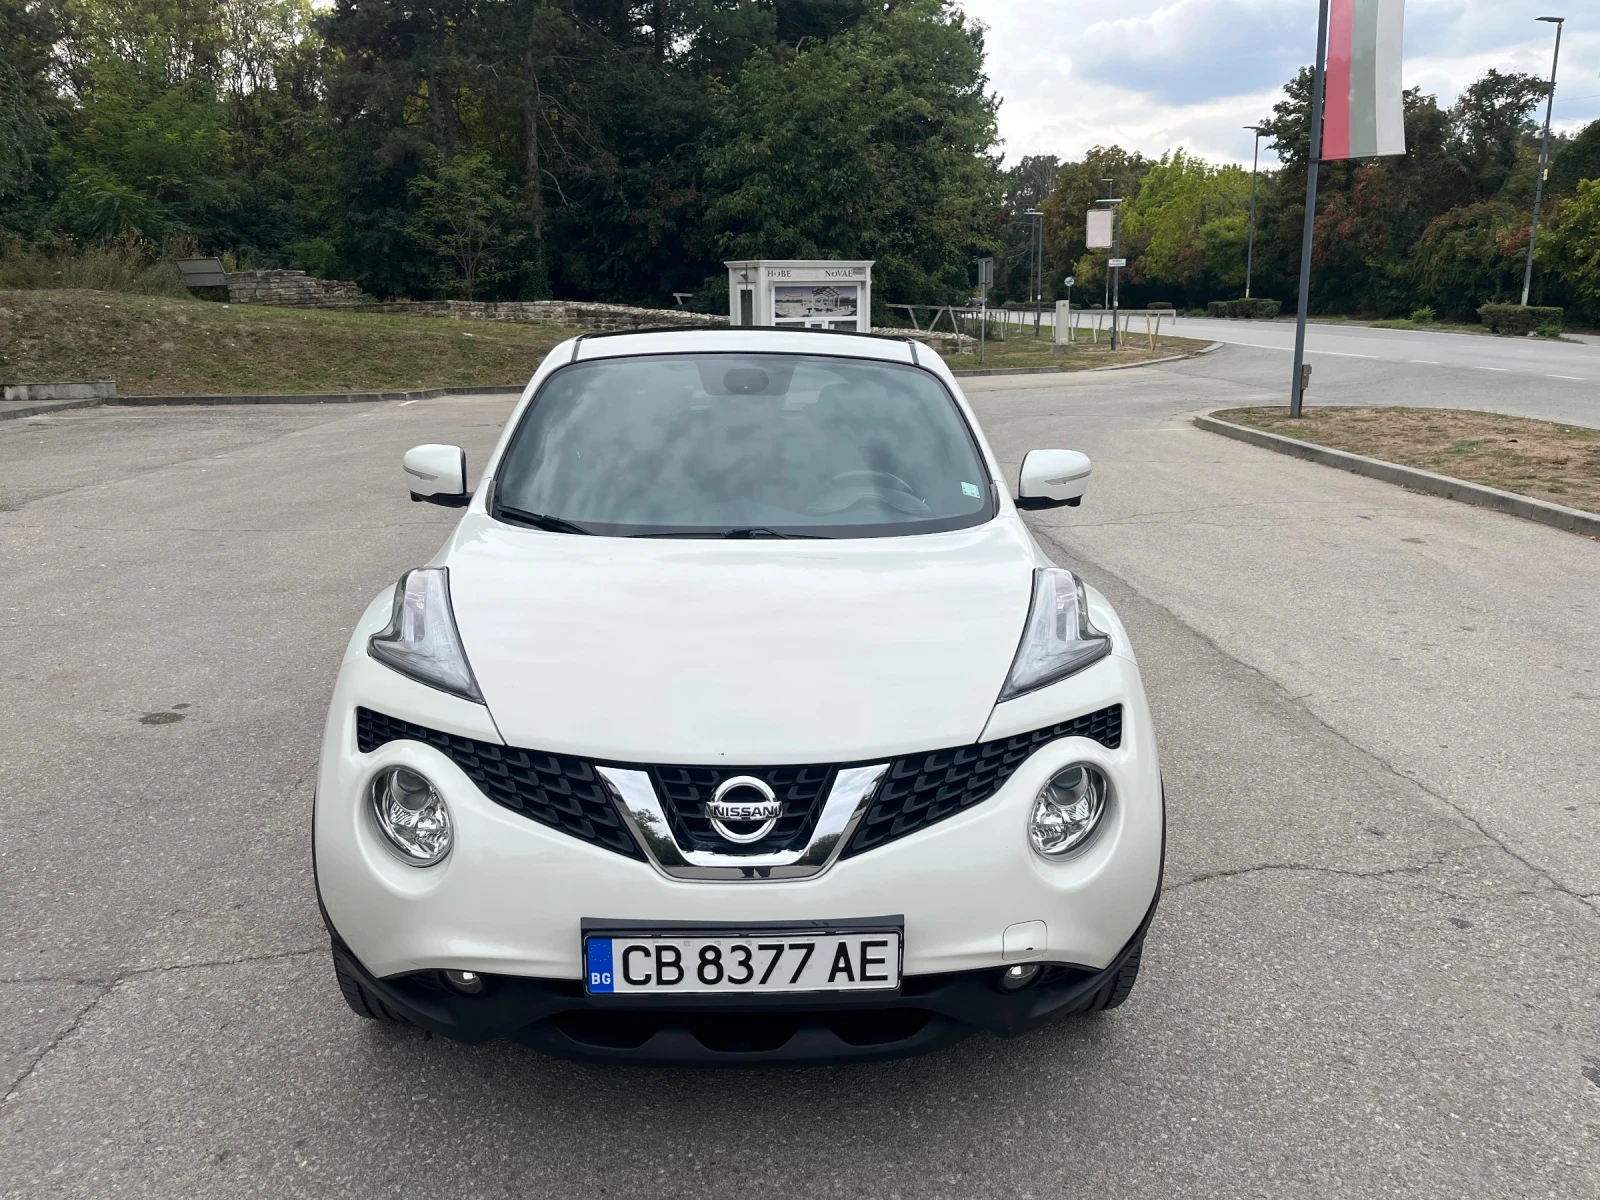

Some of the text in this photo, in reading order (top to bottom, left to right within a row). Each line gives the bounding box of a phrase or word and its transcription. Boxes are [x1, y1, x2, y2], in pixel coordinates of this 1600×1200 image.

[713, 806, 774, 817] NISSAN
[622, 940, 889, 985] CB 8377 AE
[591, 972, 611, 985] BG
